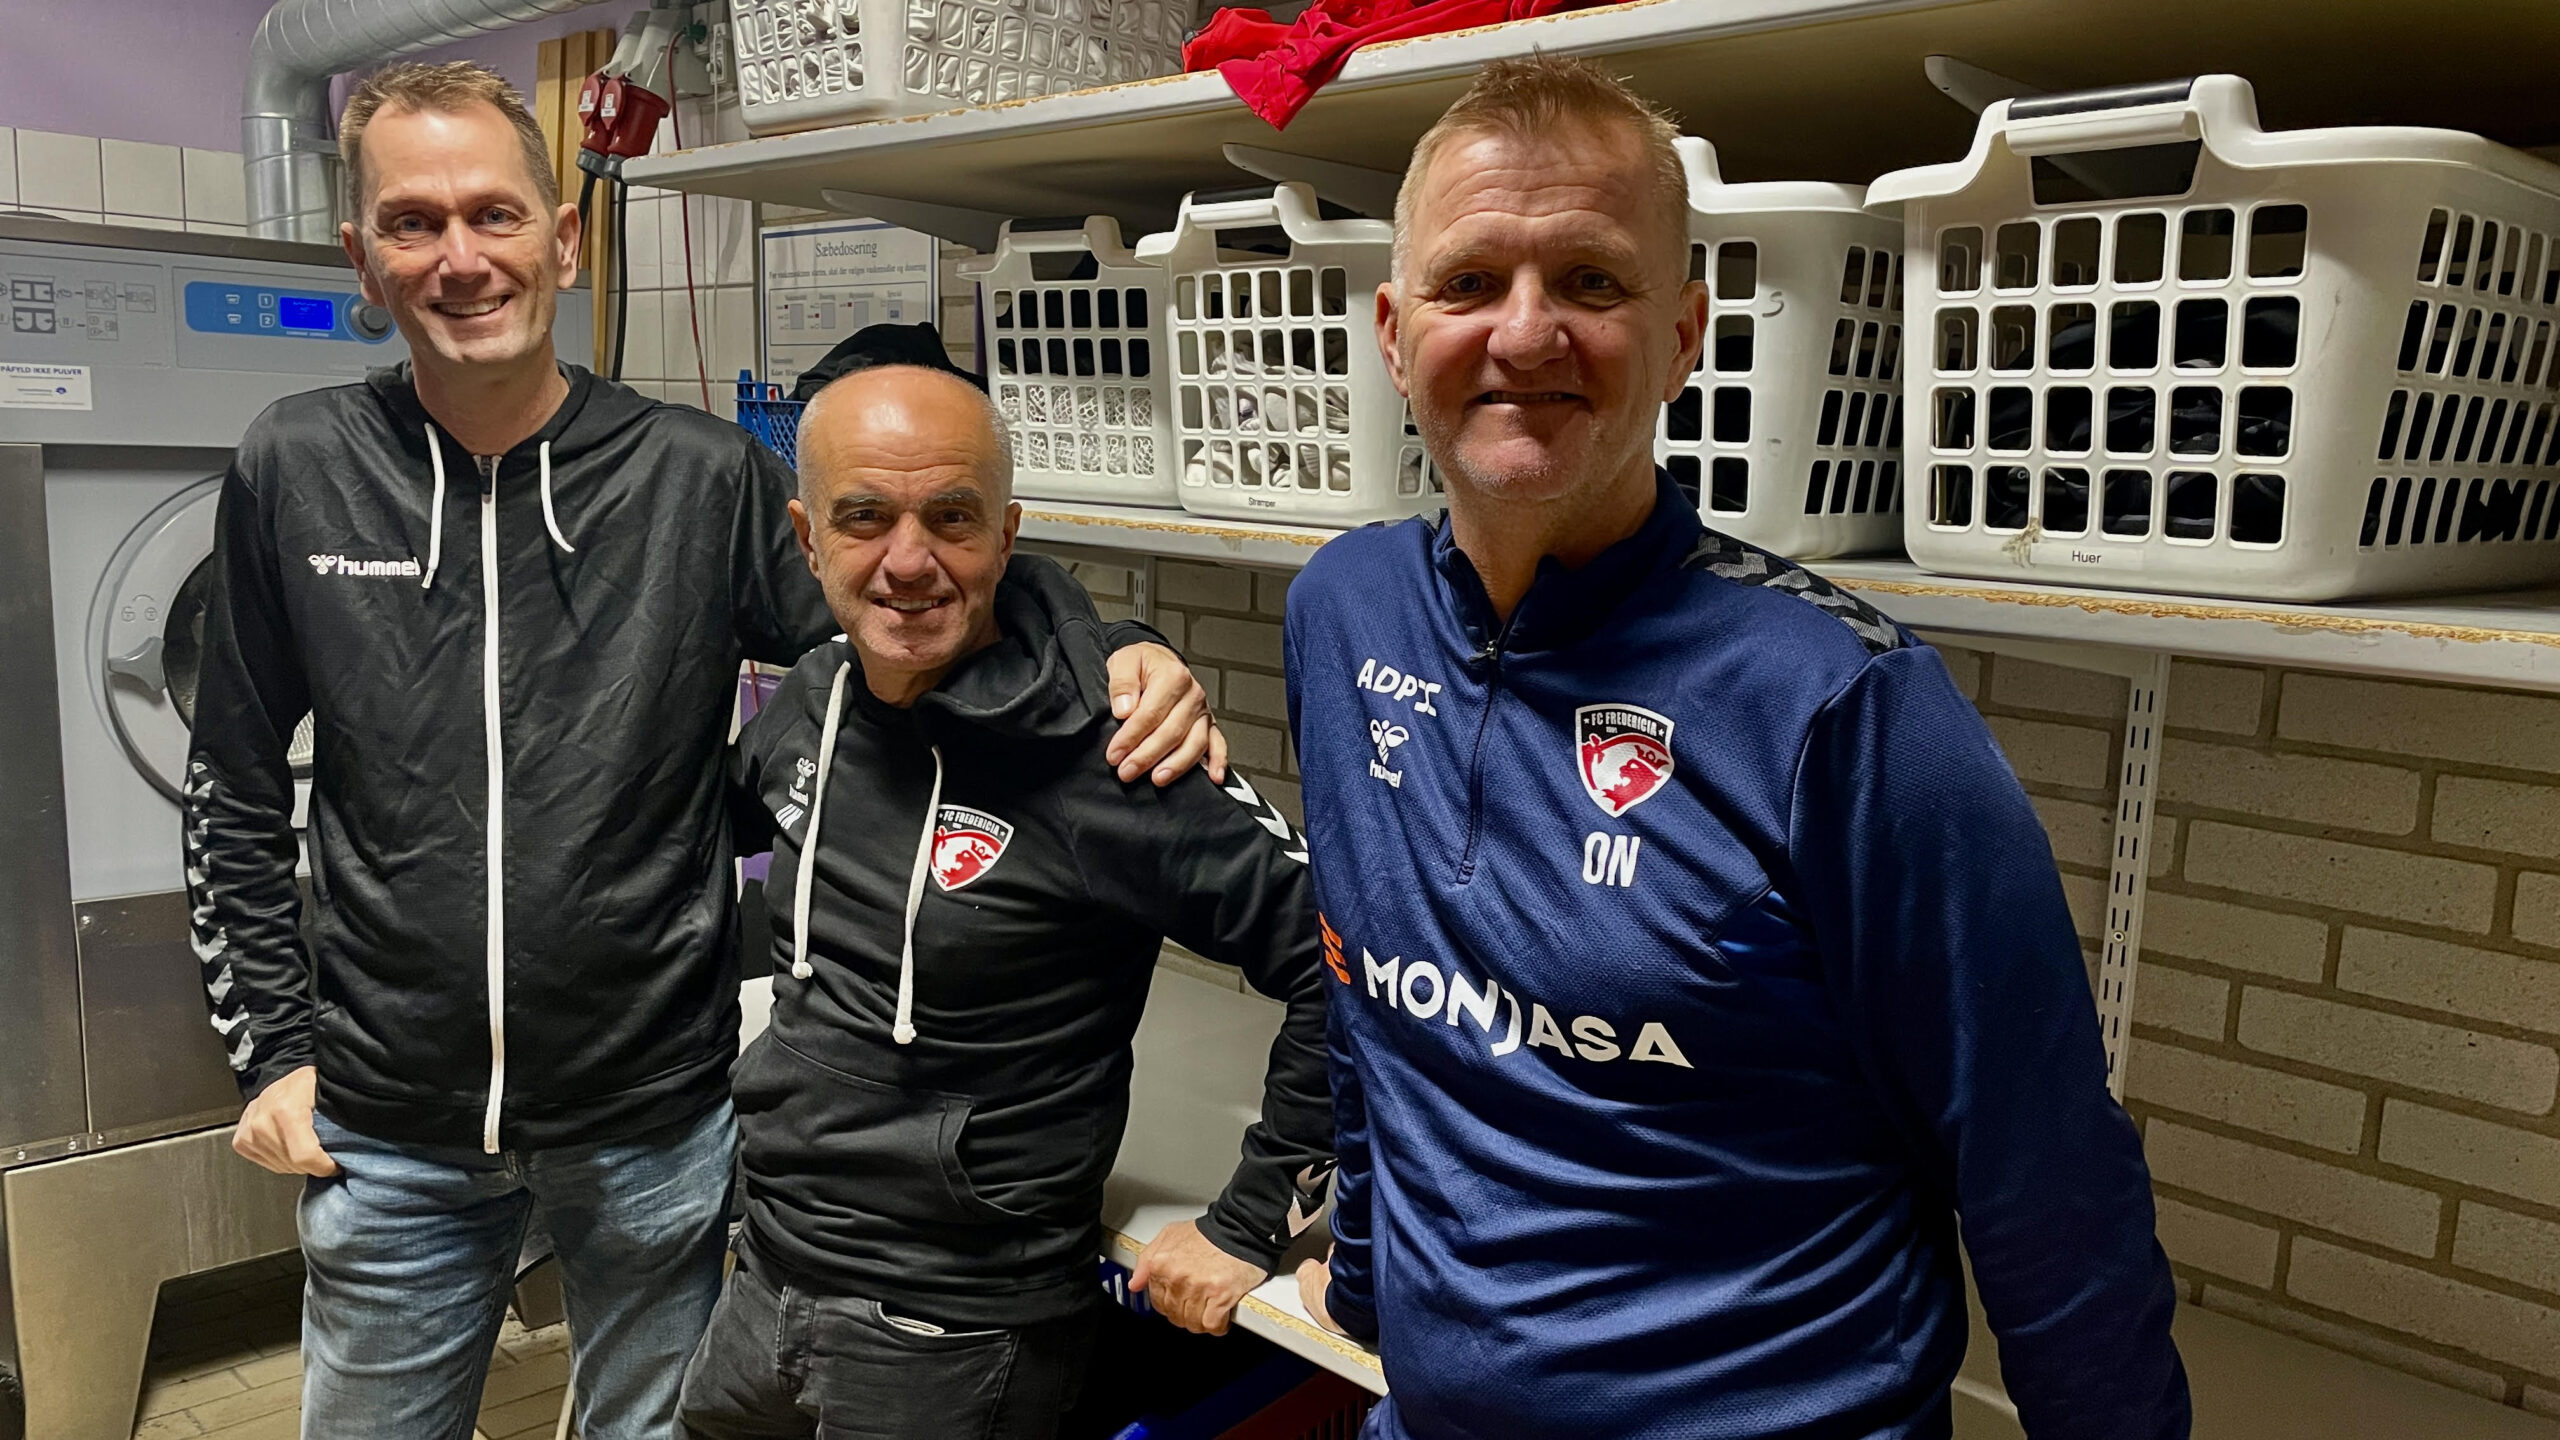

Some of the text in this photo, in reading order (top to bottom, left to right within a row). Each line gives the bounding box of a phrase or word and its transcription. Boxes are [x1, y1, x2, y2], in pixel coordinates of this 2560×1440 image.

[815, 240, 877, 258] Sæbedosering
[0, 365, 31, 373] PÅFYLD
[53, 367, 82, 375] PULVER
[337, 554, 421, 576] hummel
[2072, 550, 2102, 563] Huer
[1591, 711, 1657, 737] FC FREDERICIA
[1370, 758, 1403, 789] huel
[943, 810, 956, 822] FC
[954, 811, 1000, 837] FREDERICIA
[1582, 831, 1641, 888] ON
[1362, 946, 1695, 1070] MONJASA
